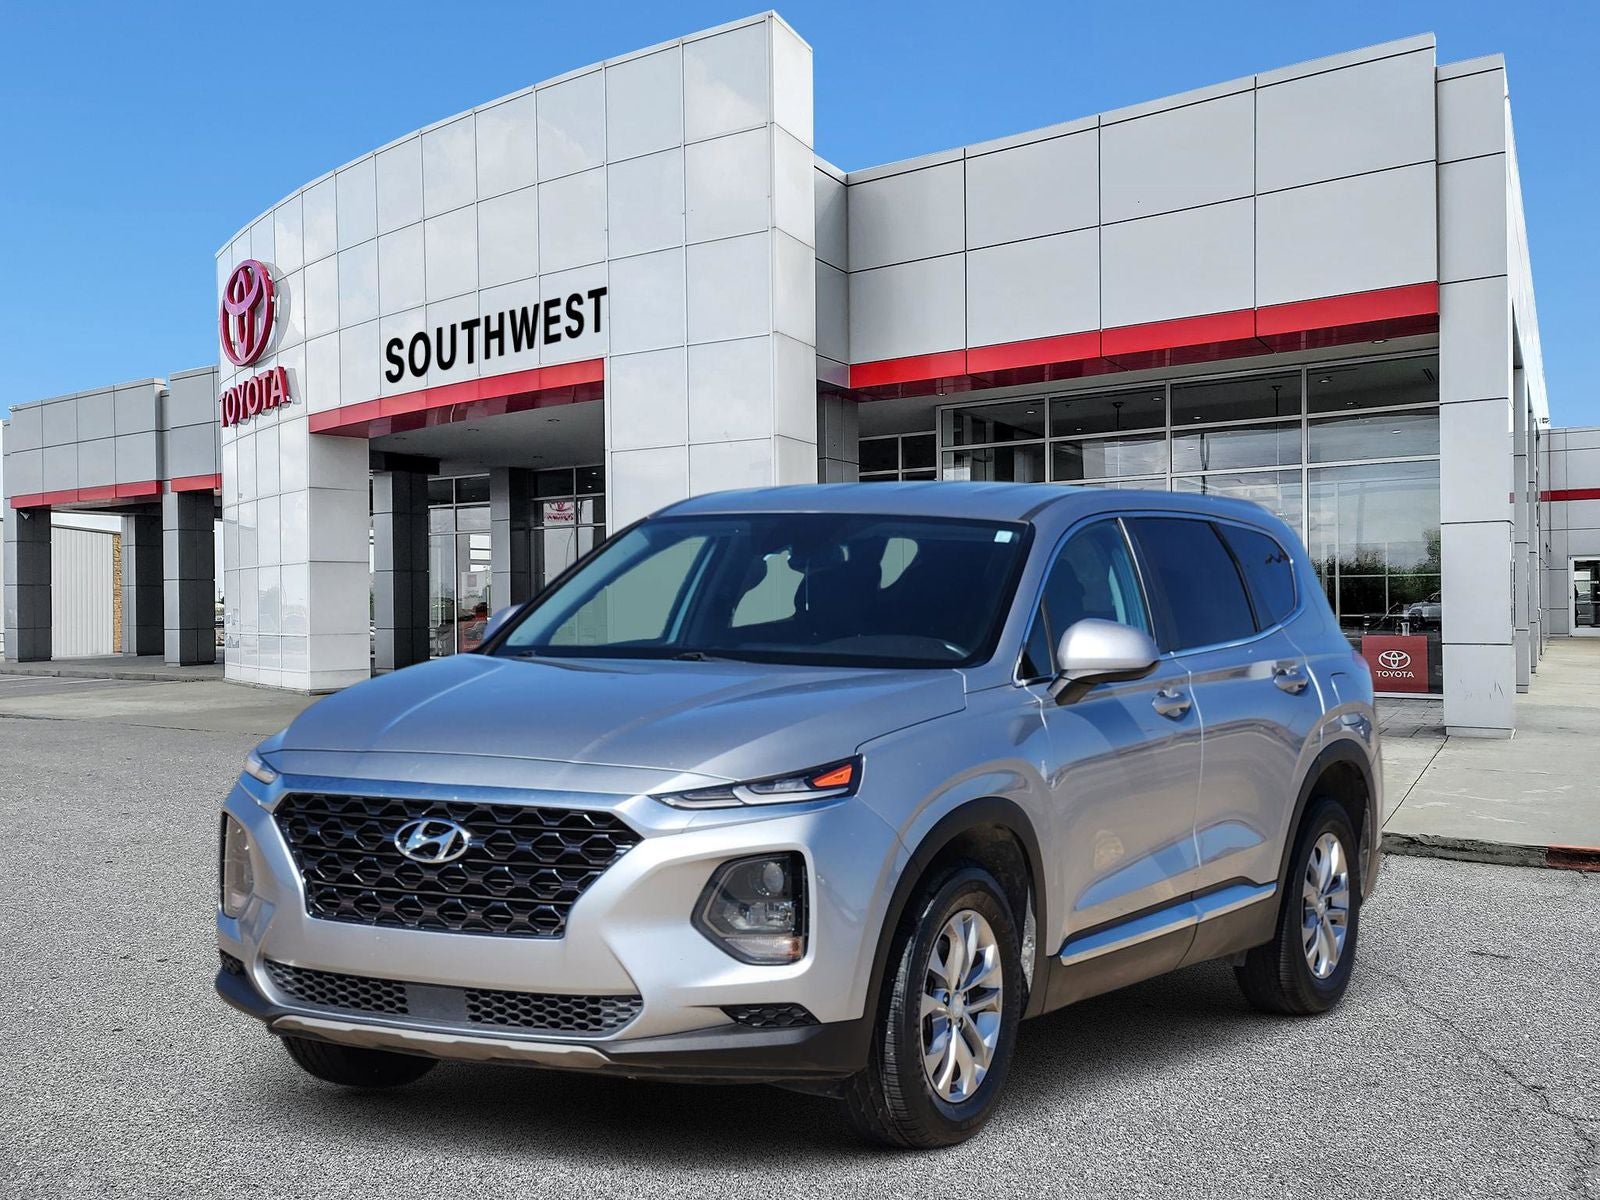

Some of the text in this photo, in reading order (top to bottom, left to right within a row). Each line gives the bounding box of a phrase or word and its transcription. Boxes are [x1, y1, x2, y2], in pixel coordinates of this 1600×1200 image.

[385, 286, 608, 384] SOUTHWEST
[219, 366, 289, 427] TOYOTA
[1376, 670, 1415, 678] TOYOTA
